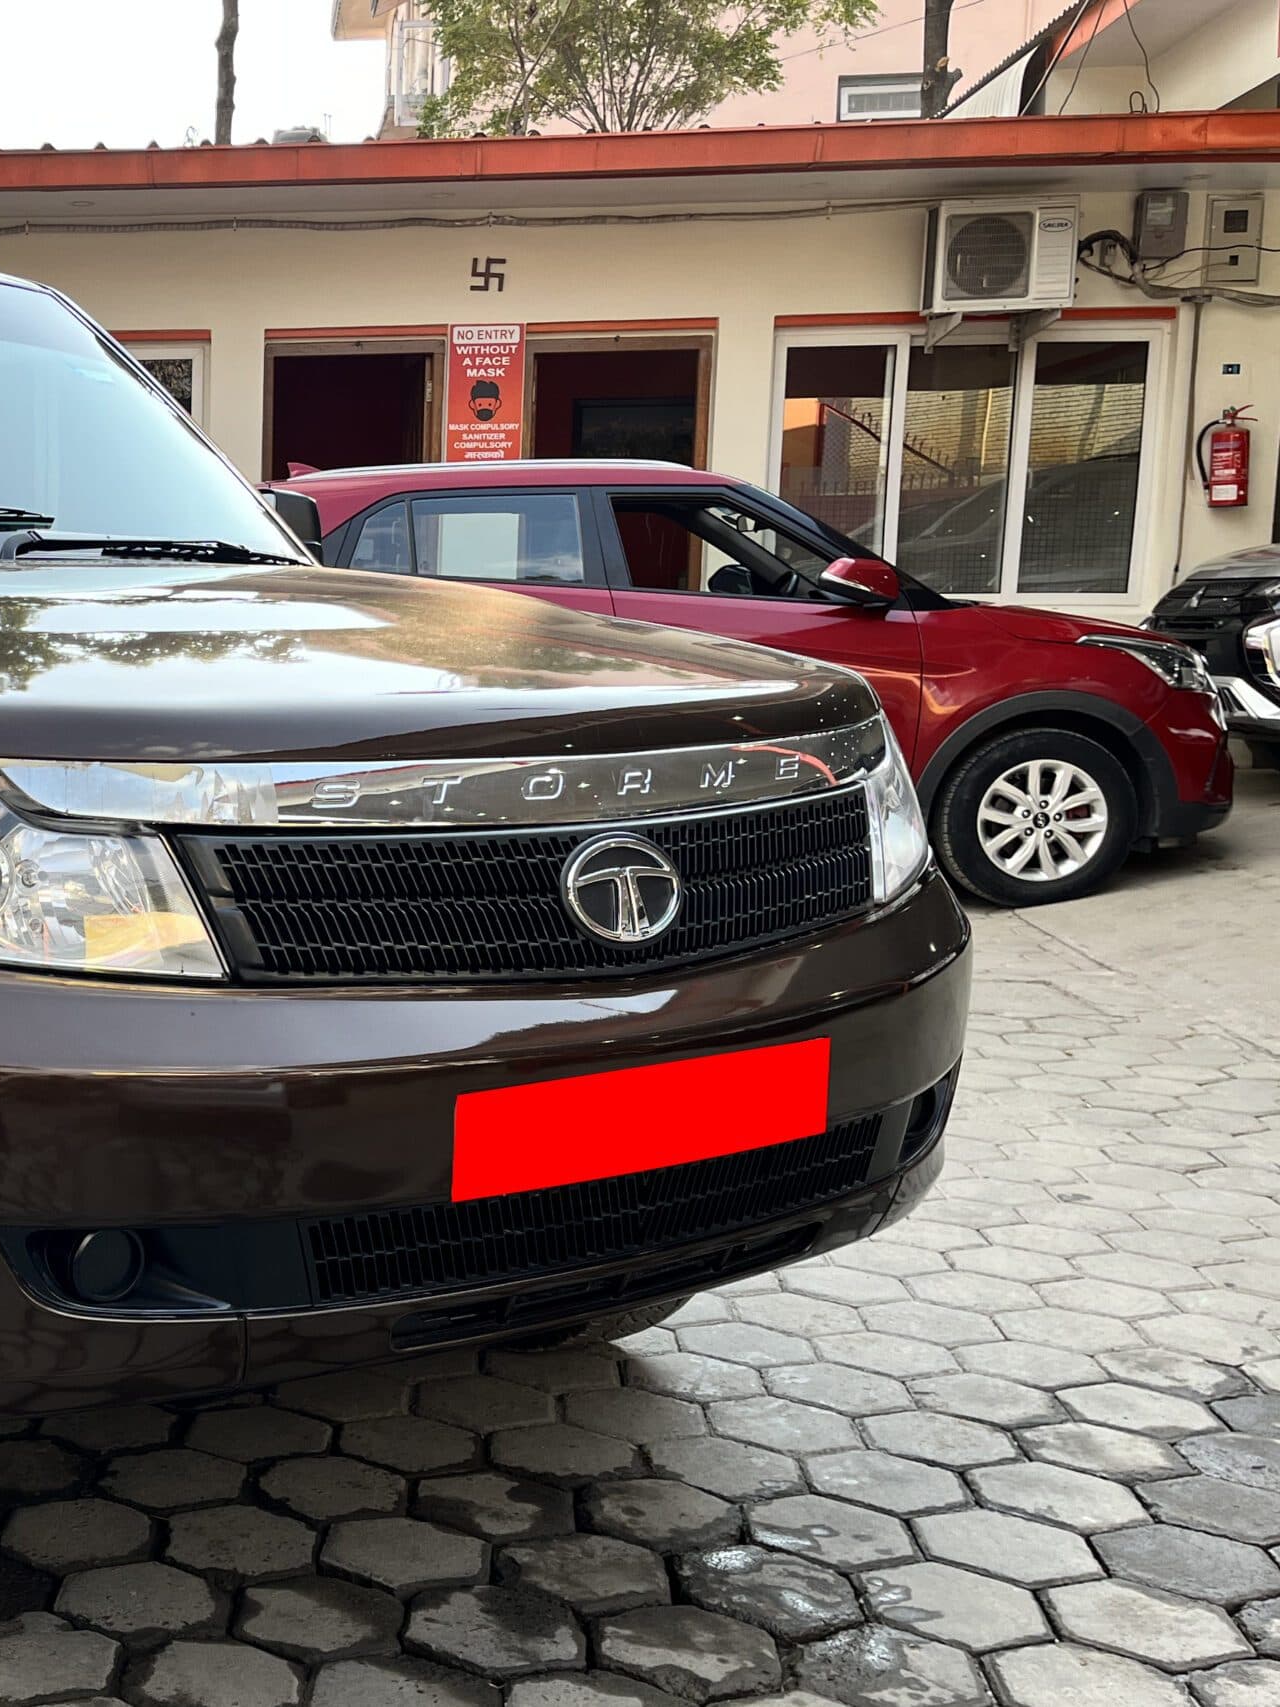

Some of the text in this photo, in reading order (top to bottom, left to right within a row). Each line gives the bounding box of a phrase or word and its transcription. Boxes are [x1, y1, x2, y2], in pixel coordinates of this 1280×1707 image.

[456, 330, 515, 340] NO ENTRY
[456, 345, 518, 355] WITHOUT
[462, 356, 510, 366] A FACE
[466, 368, 505, 377] MASK
[470, 423, 519, 431] COMPULSORY
[453, 441, 512, 449] COMPULSORY
[311, 754, 802, 809] STORME
